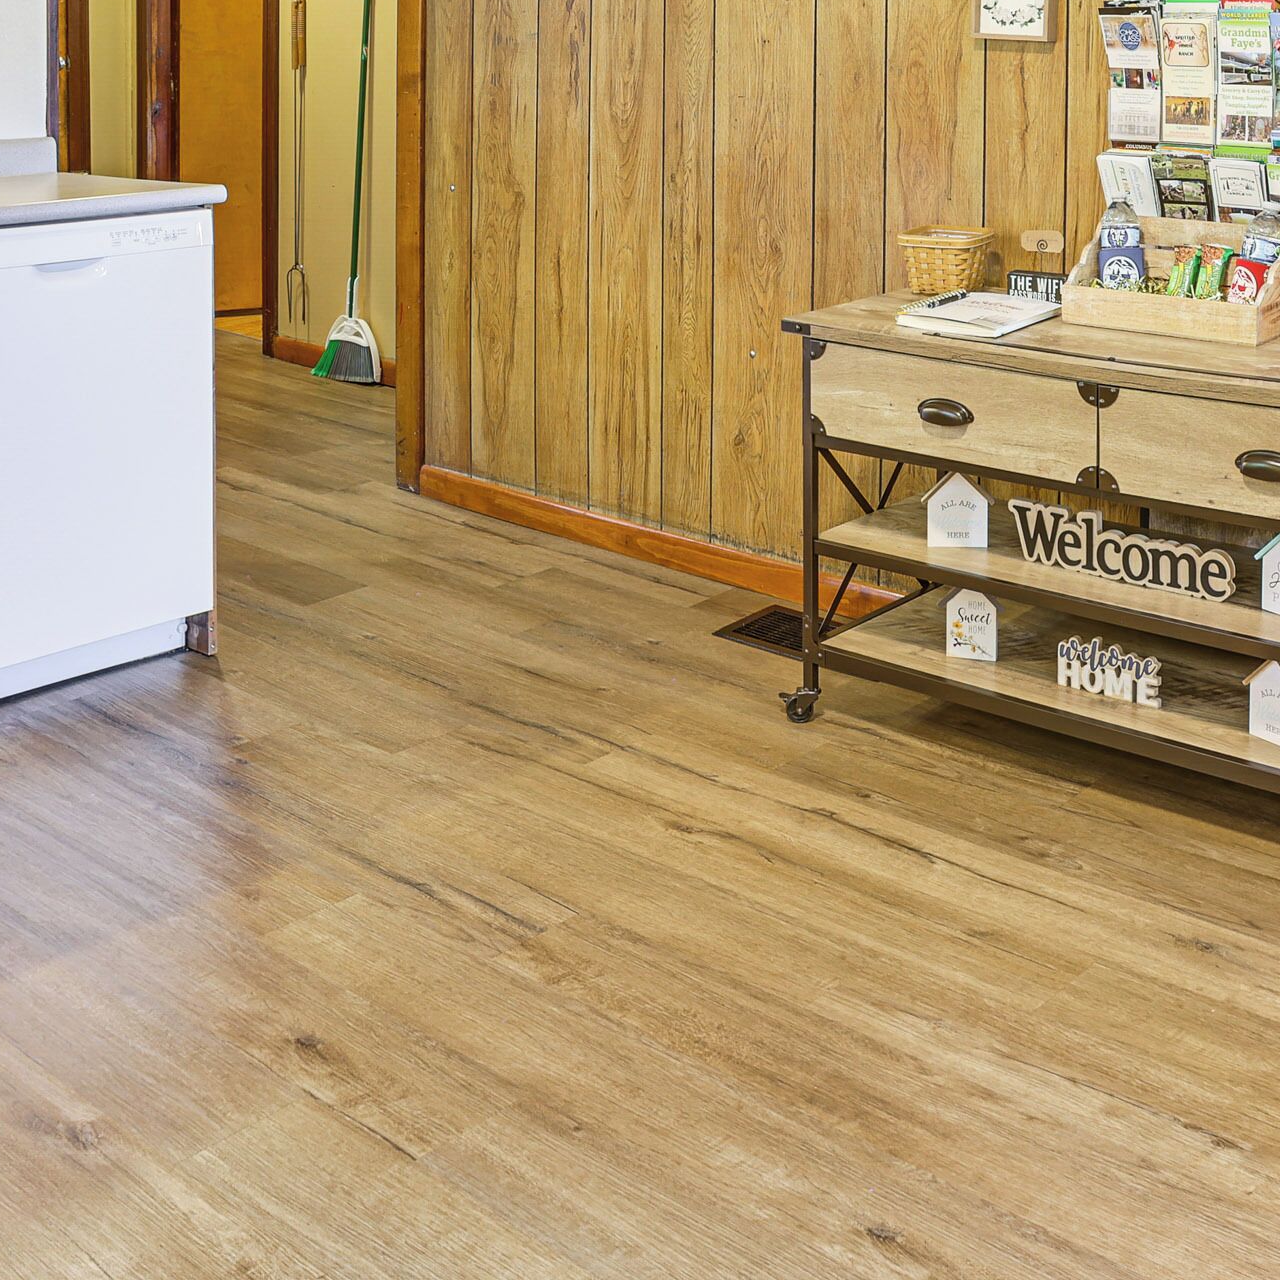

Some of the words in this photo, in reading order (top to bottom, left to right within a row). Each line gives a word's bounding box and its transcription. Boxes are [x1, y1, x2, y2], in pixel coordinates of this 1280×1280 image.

[1220, 27, 1268, 38] Grandma
[1231, 38, 1262, 50] Faye's
[1010, 275, 1032, 291] THE
[940, 499, 957, 511] ALL
[958, 499, 977, 511] ARE
[947, 531, 970, 539] HERE
[1012, 504, 1227, 598] Welcome
[968, 600, 986, 610] HOME
[957, 607, 991, 625] Sweet
[968, 625, 986, 635] HOME
[1059, 639, 1157, 680] welcome
[1057, 657, 1162, 709] HOME
[1260, 688, 1276, 698] ALL
